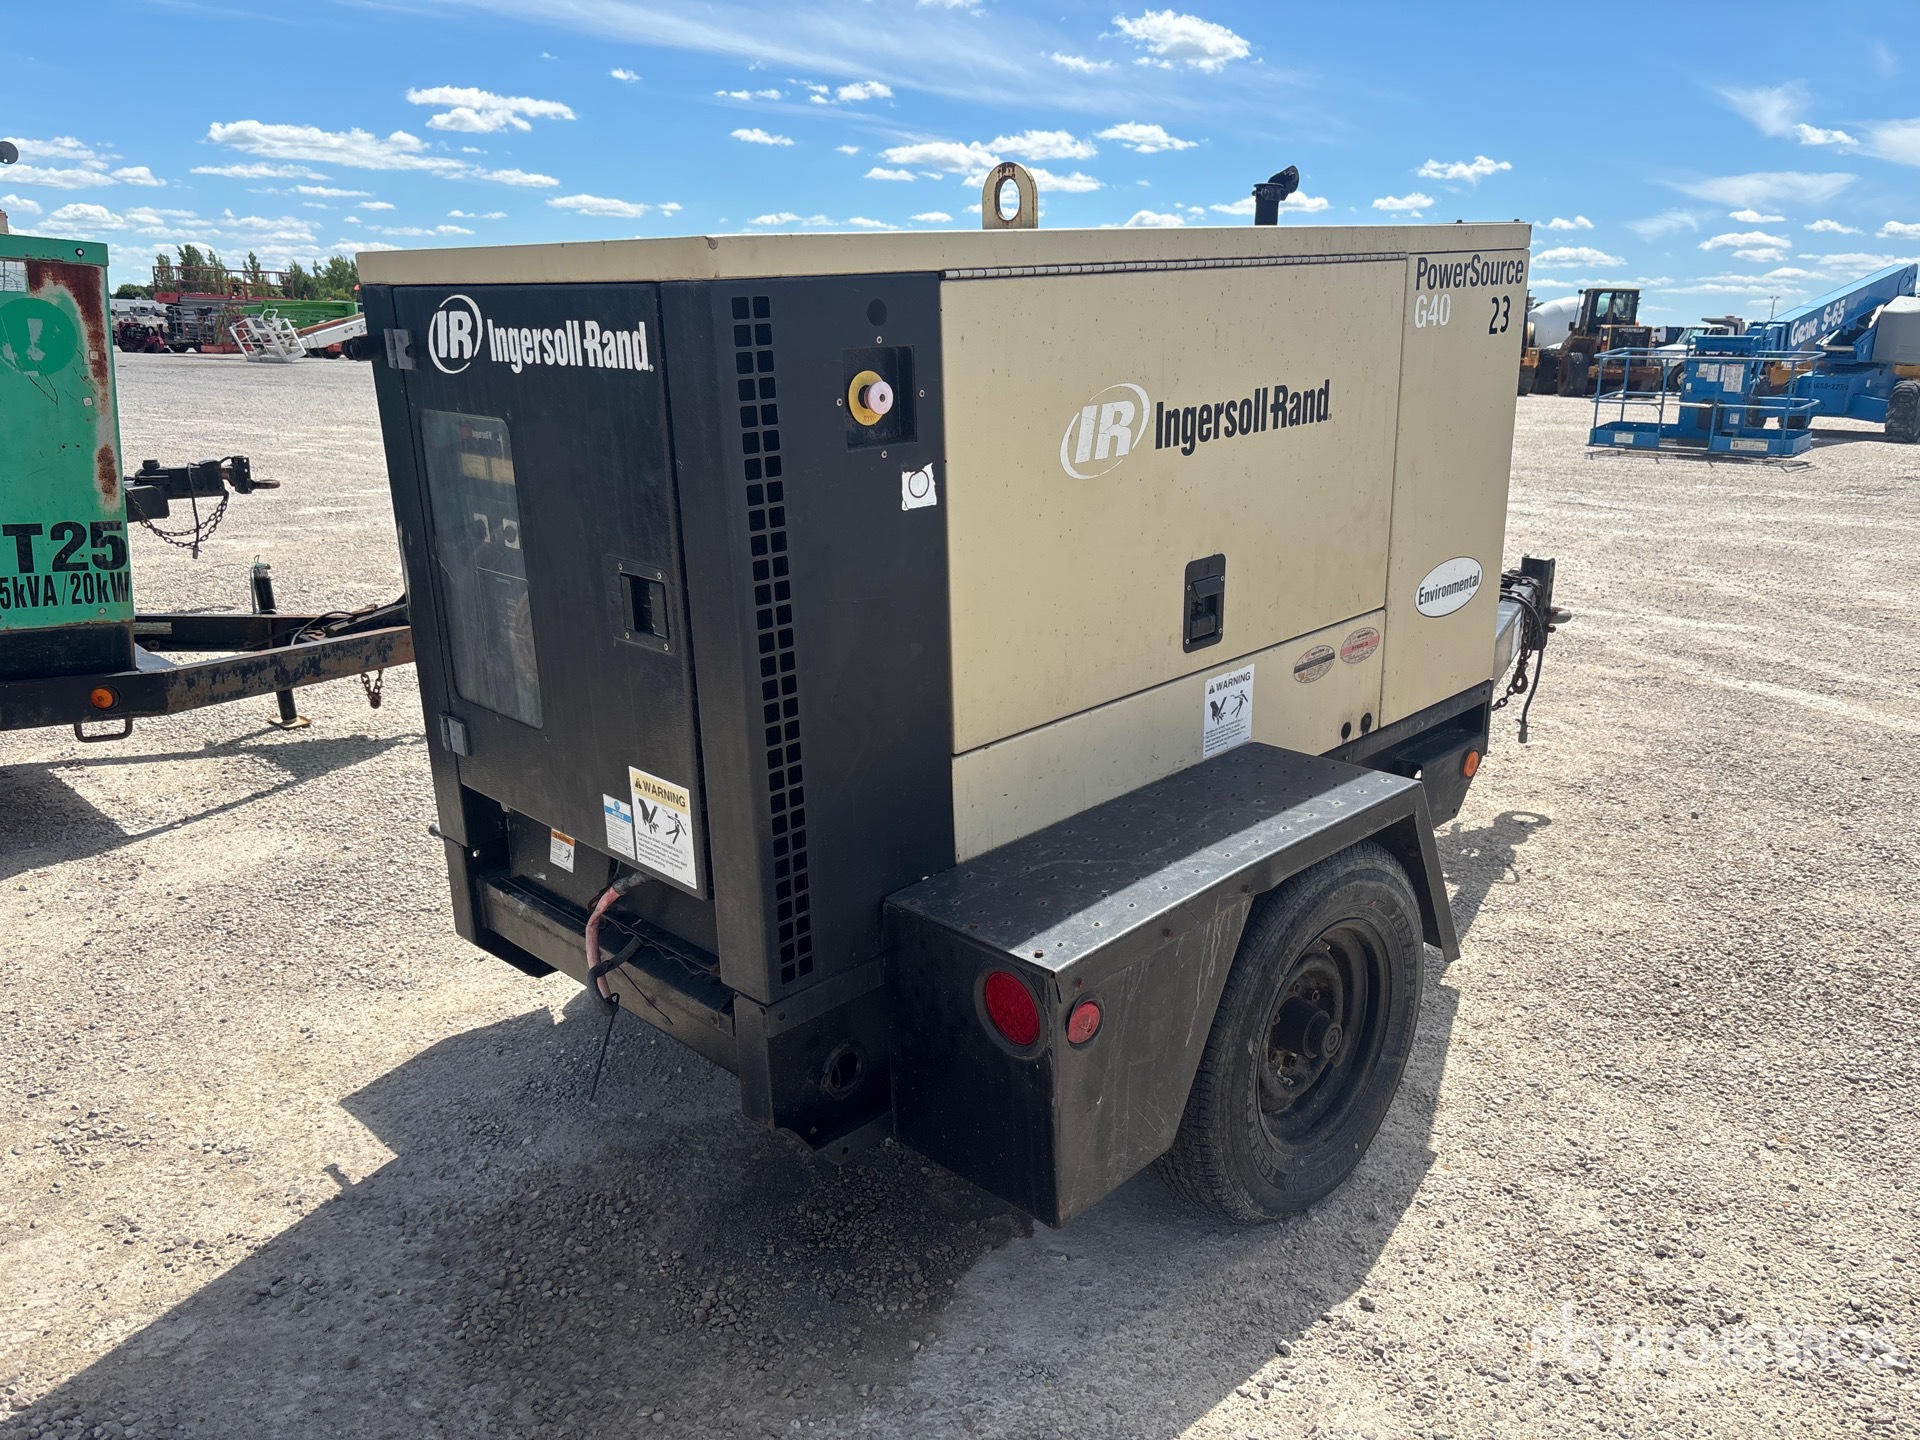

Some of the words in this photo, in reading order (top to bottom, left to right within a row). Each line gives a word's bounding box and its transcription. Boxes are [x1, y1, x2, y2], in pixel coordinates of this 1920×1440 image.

[1415, 253, 1524, 291] PowerSource
[1414, 293, 1451, 329] G40
[1488, 295, 1511, 335] 23
[1790, 317, 1818, 347] Genie
[1821, 299, 1846, 332] S-65
[435, 310, 473, 360] IR
[1074, 400, 1136, 464] IR
[1418, 569, 1481, 606] Environmental
[1215, 671, 1251, 692] WARNING
[642, 779, 686, 808] WARNING
